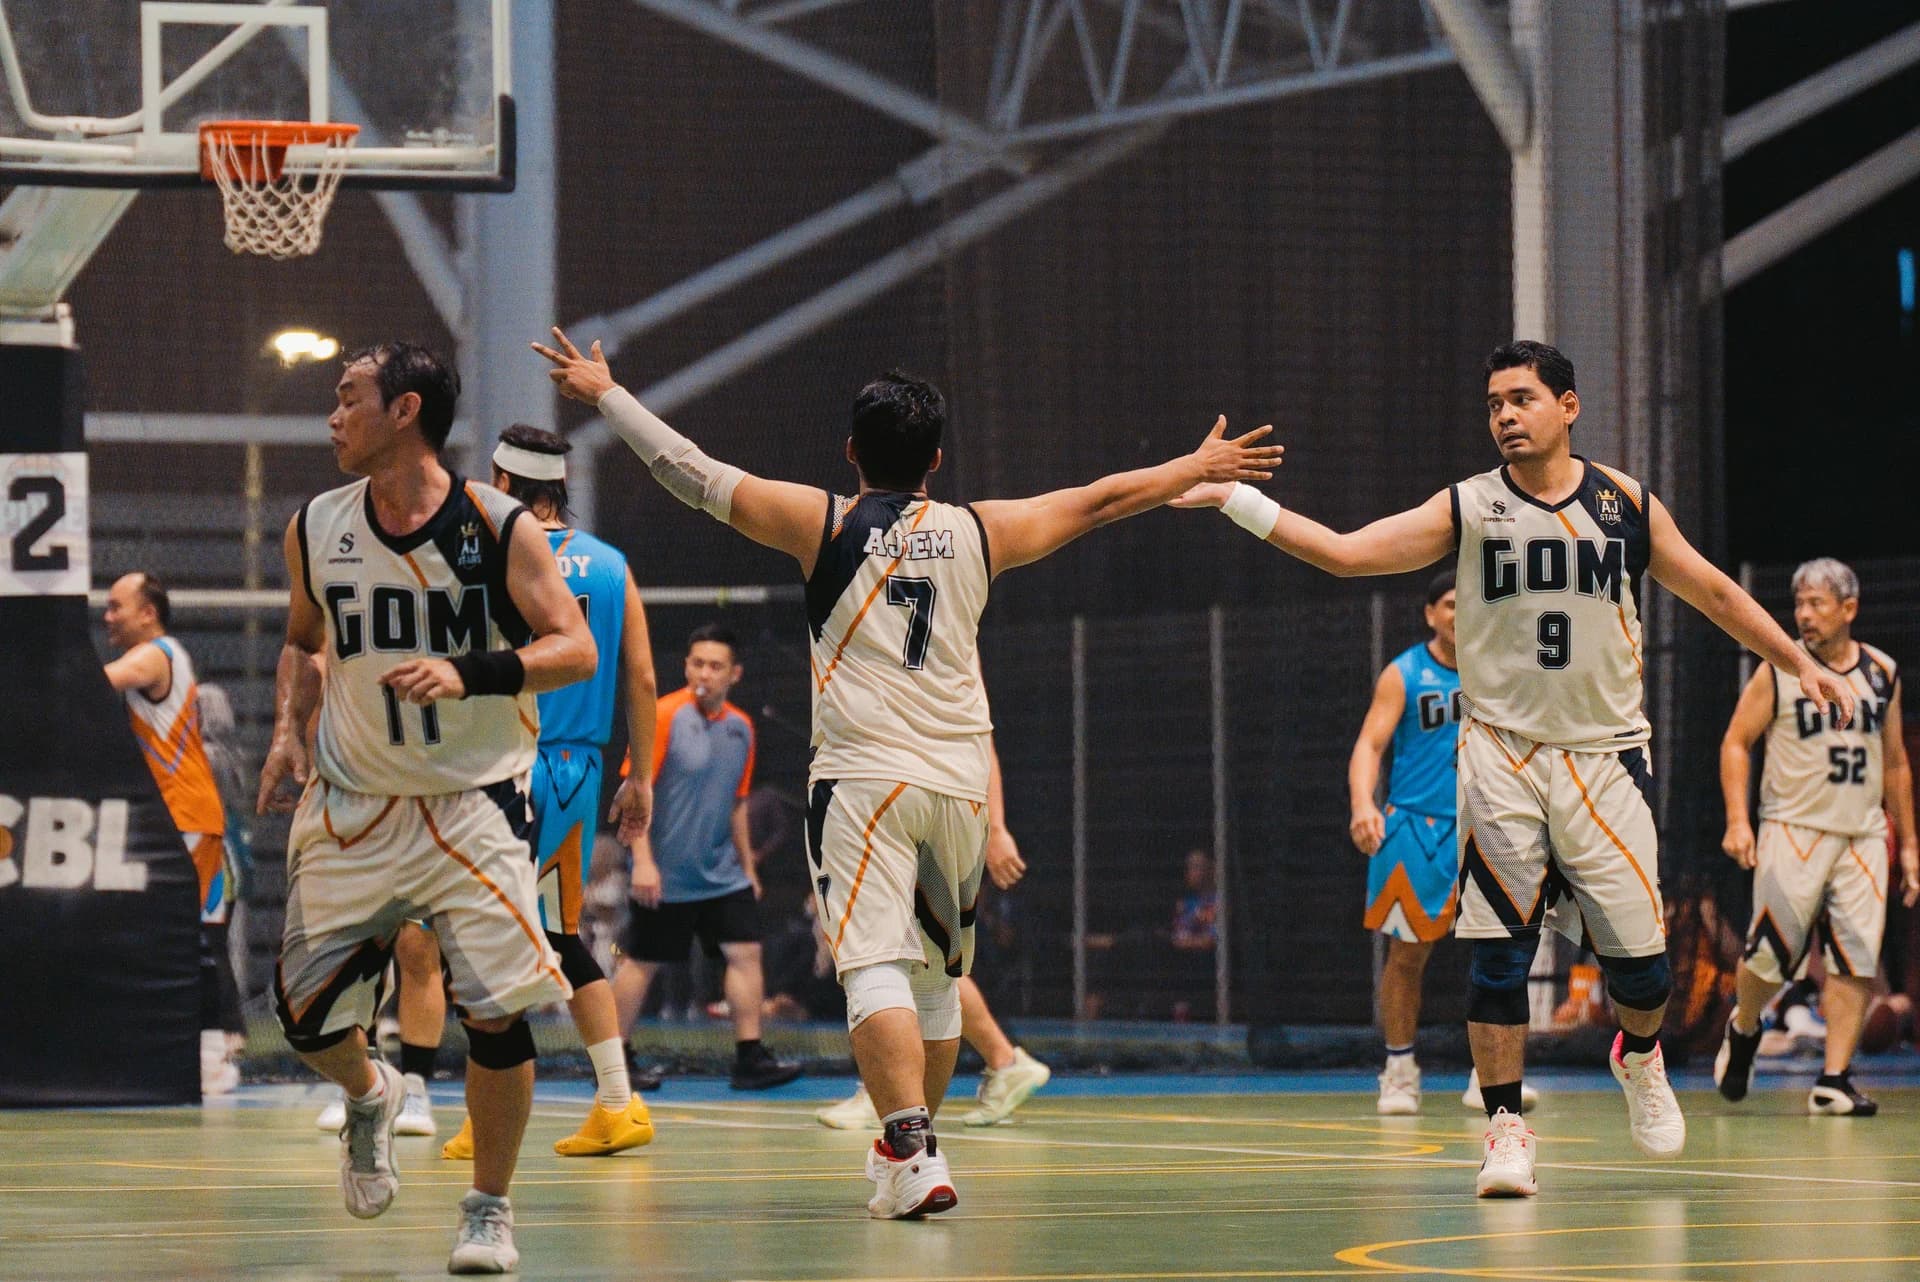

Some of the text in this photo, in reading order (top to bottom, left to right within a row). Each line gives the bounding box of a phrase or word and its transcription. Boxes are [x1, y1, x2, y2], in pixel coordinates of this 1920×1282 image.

[9, 477, 69, 571] 2
[1601, 500, 1619, 514] AJ
[555, 555, 592, 578] DY
[1480, 536, 1626, 608] GOM
[323, 580, 492, 664] GOM
[887, 575, 937, 671] 7
[1537, 611, 1571, 670] 9
[381, 683, 441, 745] 11
[1828, 746, 1867, 784] 52
